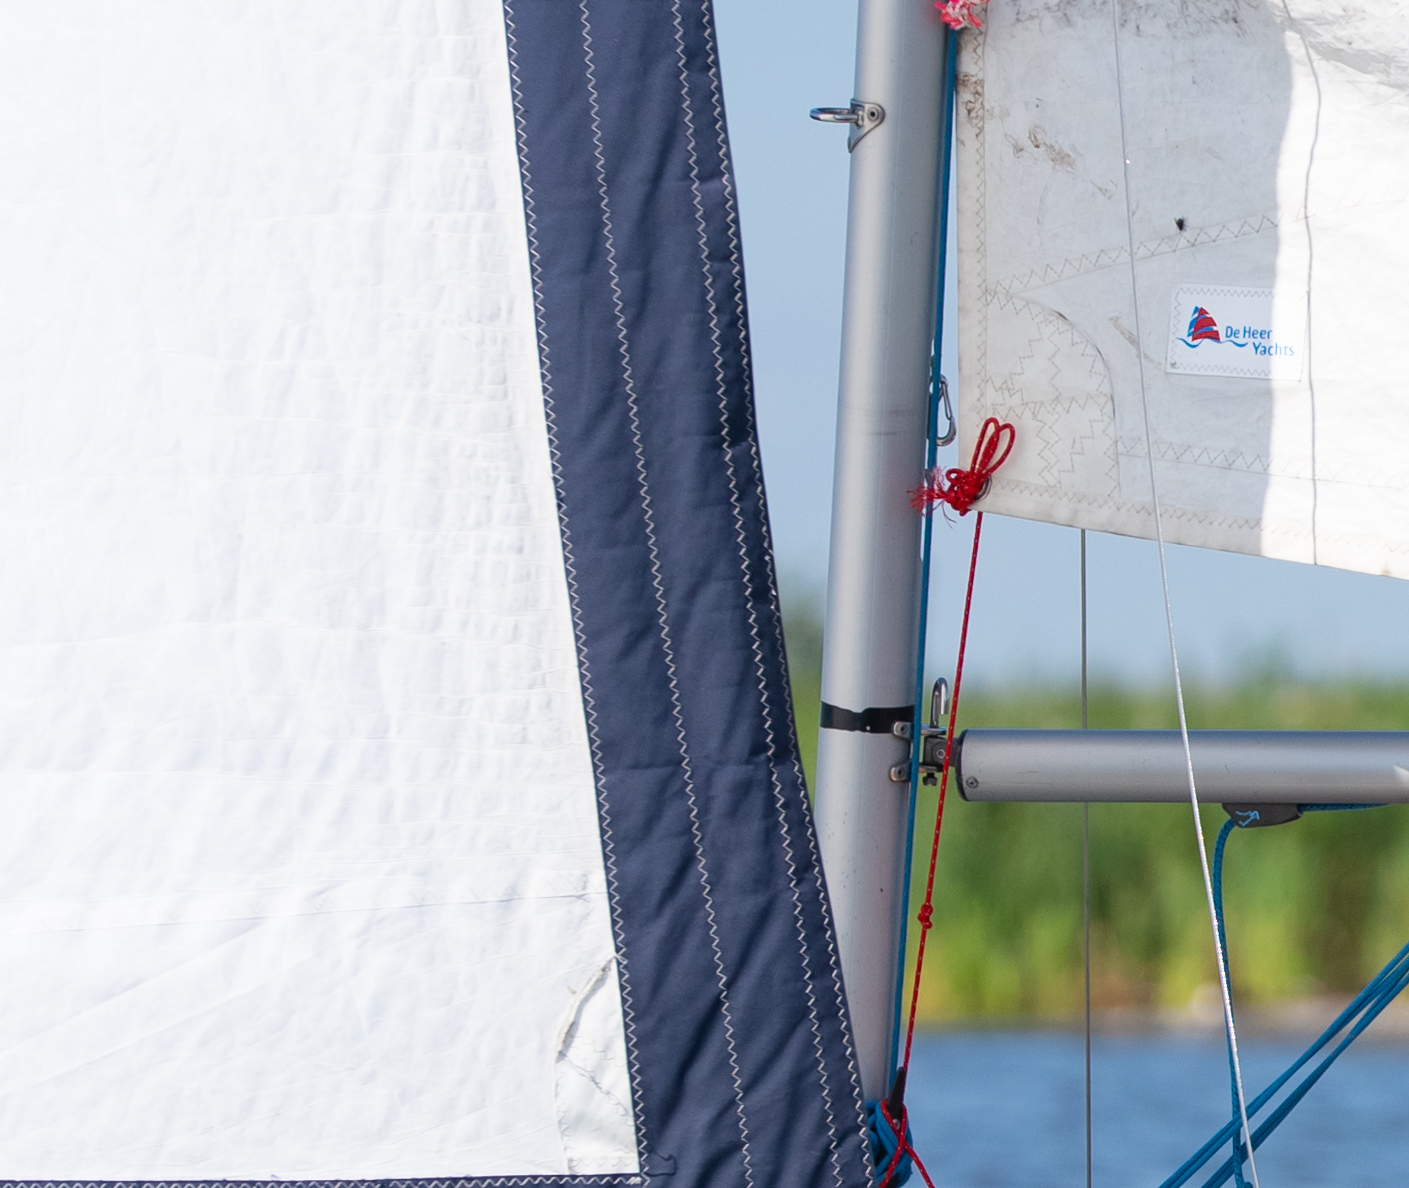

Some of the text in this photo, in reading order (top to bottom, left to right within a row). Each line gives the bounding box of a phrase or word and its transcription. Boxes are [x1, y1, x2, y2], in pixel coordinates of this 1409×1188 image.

[1225, 325, 1273, 339] De Heer
[1252, 341, 1295, 356] Yachts
